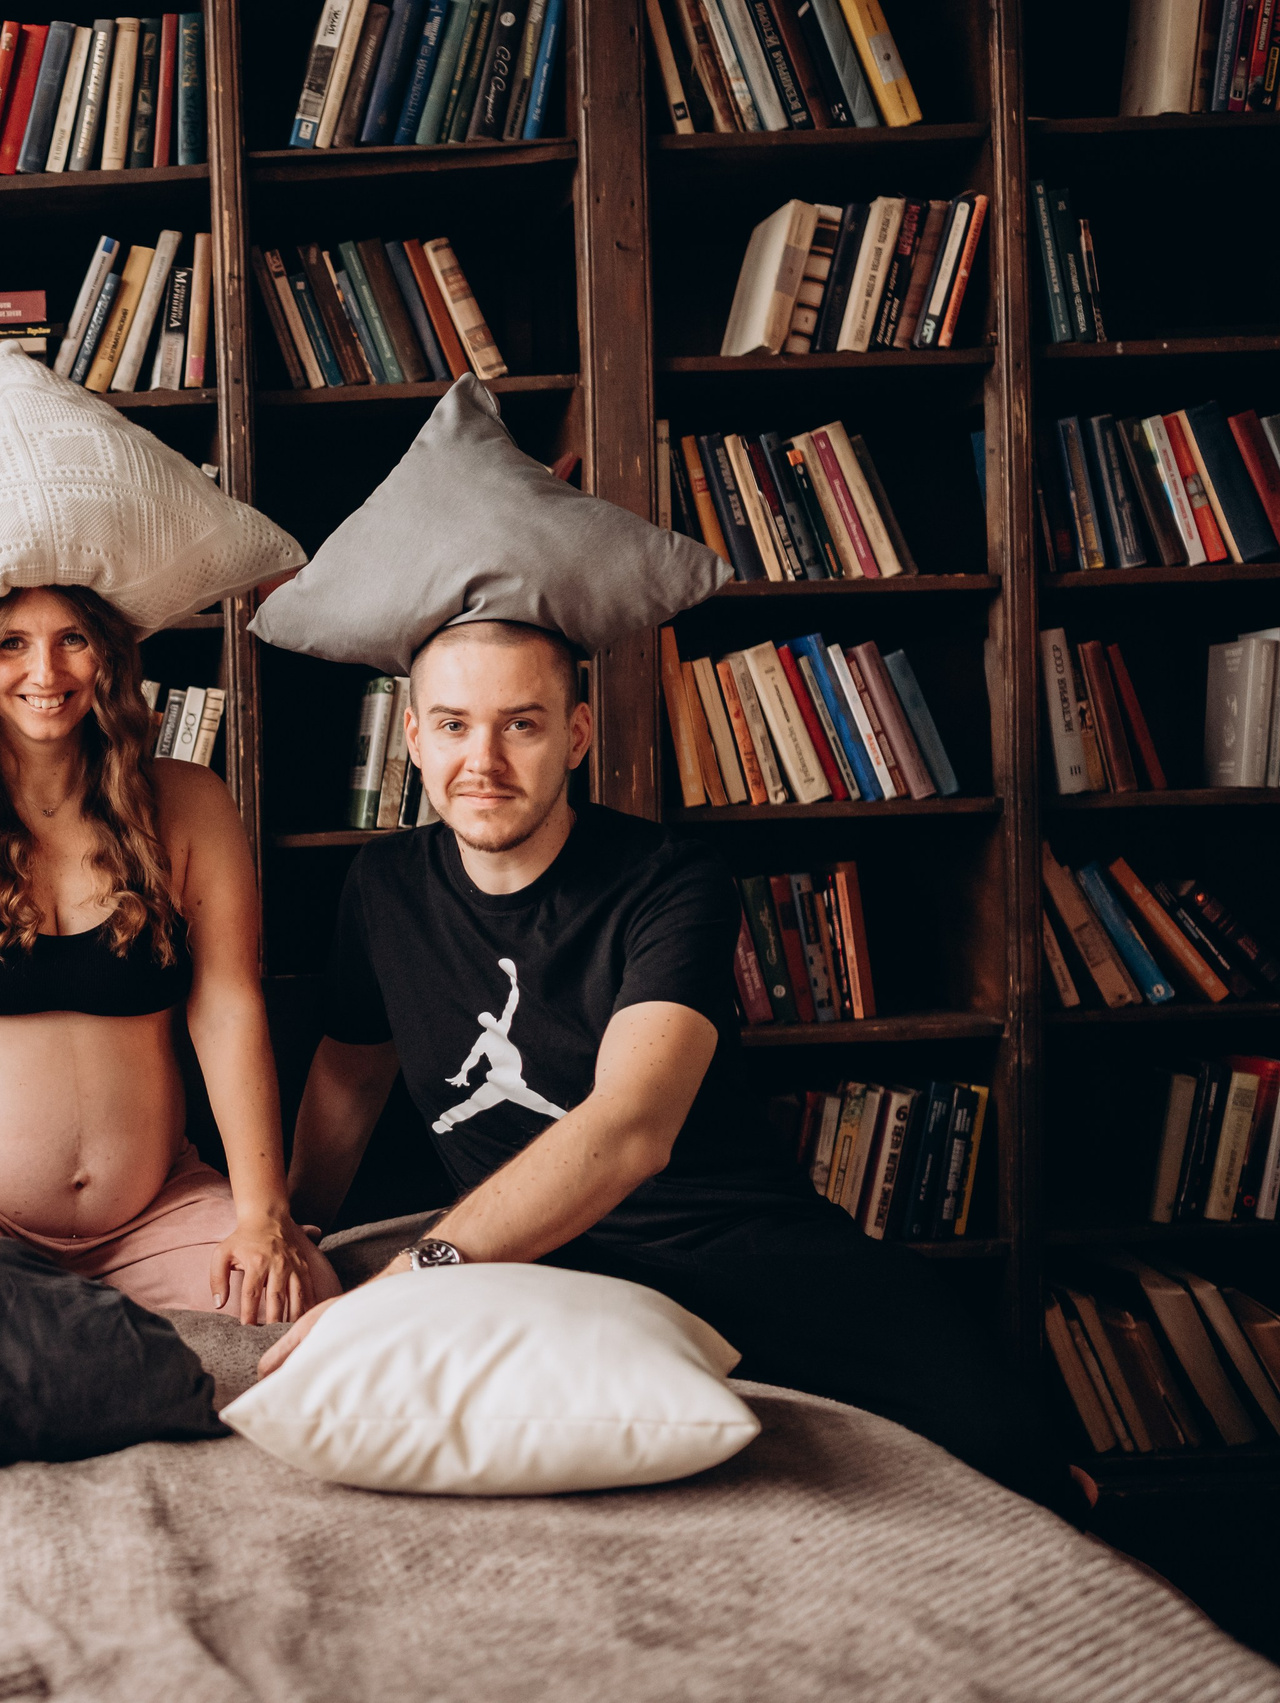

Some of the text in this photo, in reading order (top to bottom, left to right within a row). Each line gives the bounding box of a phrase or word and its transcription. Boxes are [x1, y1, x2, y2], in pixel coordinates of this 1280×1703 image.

[751, 0, 802, 111] ВСЕМИРНАЯ ИСТОРИЯ
[1256, 16, 1268, 50] НОВИНКИ
[84, 29, 108, 102] АЙТМАТОВ
[1217, 52, 1231, 100] ВЕТЕРИНАРНАЯ
[896, 202, 922, 256] ШЕЛДОН
[1038, 196, 1060, 293] ВСЕМИРНАЯ ИСТОРИЯ
[83, 287, 96, 309] теории
[91, 254, 107, 288] гомологий
[166, 269, 189, 329] МАРИНИНА
[1066, 252, 1087, 333] АНАТОМИЯ ЧЕЛОВЕКА
[80, 292, 111, 355] АХМАТОВА
[104, 306, 130, 362] ДОЛМАТОВСКИЙ
[874, 298, 892, 343] Незнакомец
[882, 296, 901, 346] Конец света
[712, 446, 746, 527] ДЖЕК ЛОНДОН
[1051, 642, 1073, 732] ИСТОРИЯ СССР
[742, 968, 758, 1001] жизни
[744, 951, 763, 989] История
[895, 1104, 909, 1122] 6
[872, 1186, 892, 1229] ДЖЕЙМС
[888, 1123, 904, 1150] ЧЕЙЗ
